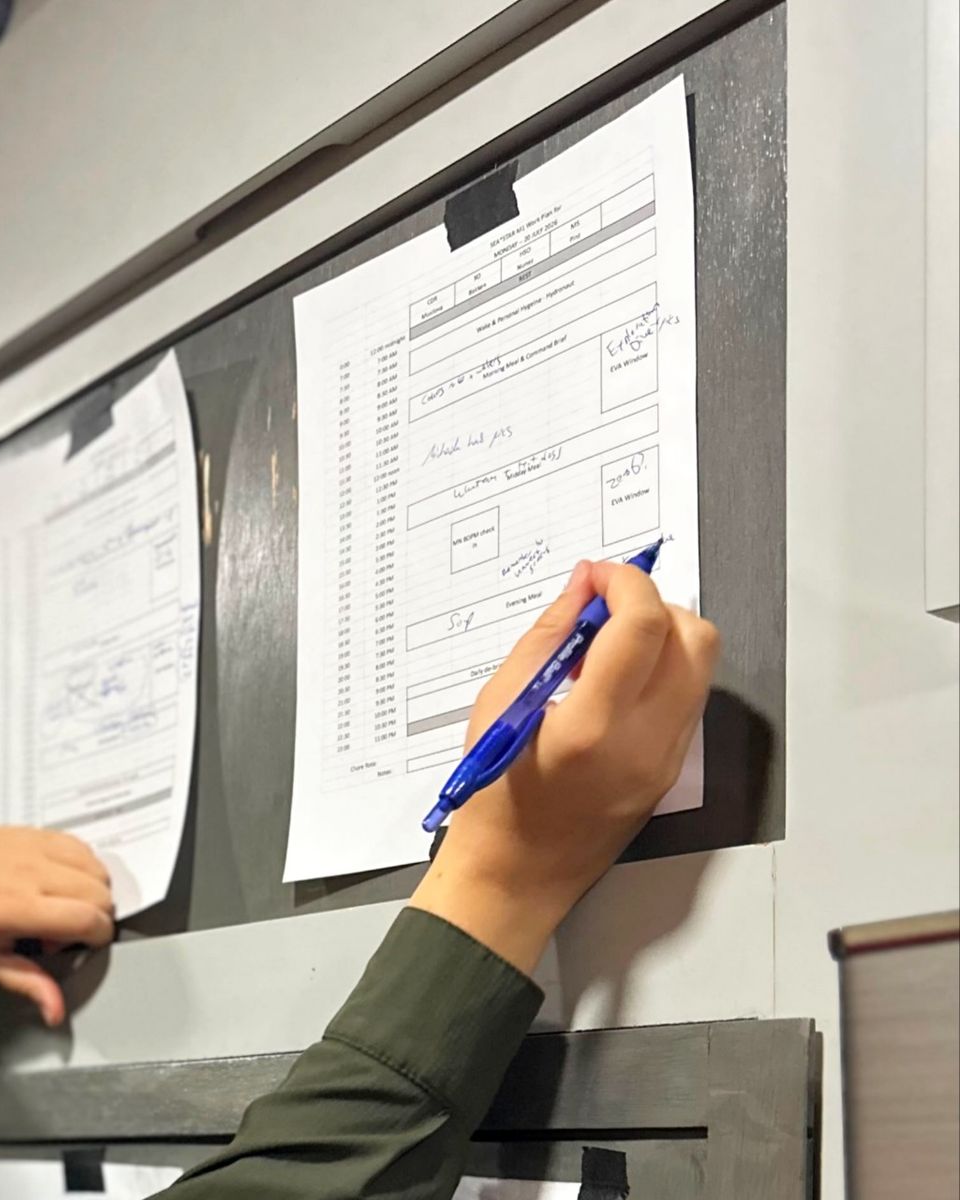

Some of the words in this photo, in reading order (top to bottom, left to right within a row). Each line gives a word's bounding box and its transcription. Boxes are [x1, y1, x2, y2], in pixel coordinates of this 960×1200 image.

[526, 218, 540, 228] Work
[494, 240, 518, 258] MONDAY
[531, 227, 544, 238] JULY
[476, 323, 490, 334] Wake
[497, 309, 520, 324] Personal
[388, 349, 398, 358] AM
[505, 358, 520, 369] Meal
[525, 342, 553, 360] Command
[553, 334, 568, 346] Brief
[622, 352, 648, 368] Window
[388, 361, 398, 370] AM
[388, 372, 398, 382] AM
[388, 384, 398, 394] AM
[388, 396, 398, 406] AM
[388, 408, 398, 418] AM
[390, 419, 400, 428] AM
[390, 431, 400, 440] AM
[390, 443, 400, 452] AM
[390, 455, 400, 464] AM
[390, 479, 398, 488] PM
[386, 491, 396, 500] PM
[610, 496, 624, 506] EVA
[624, 488, 650, 502] Window
[386, 503, 396, 512] PM
[386, 515, 396, 524] PM
[386, 527, 396, 536] PM
[386, 538, 396, 548] PM
[386, 550, 394, 558] PM
[386, 562, 394, 570] PM
[386, 574, 394, 582] PM
[386, 586, 394, 594] PM
[386, 598, 394, 606] PM
[505, 594, 528, 609] Evening
[528, 591, 543, 601] Meal
[386, 610, 394, 618] PM
[386, 622, 394, 630] PM
[386, 634, 394, 642] PM
[386, 646, 396, 654] PM
[386, 658, 396, 666] PM
[386, 671, 396, 680] PM
[470, 667, 484, 678] Daily
[386, 682, 396, 690] PM
[386, 695, 396, 704] PM
[388, 706, 396, 714] PM
[388, 718, 396, 726] PM
[388, 730, 396, 738] PM
